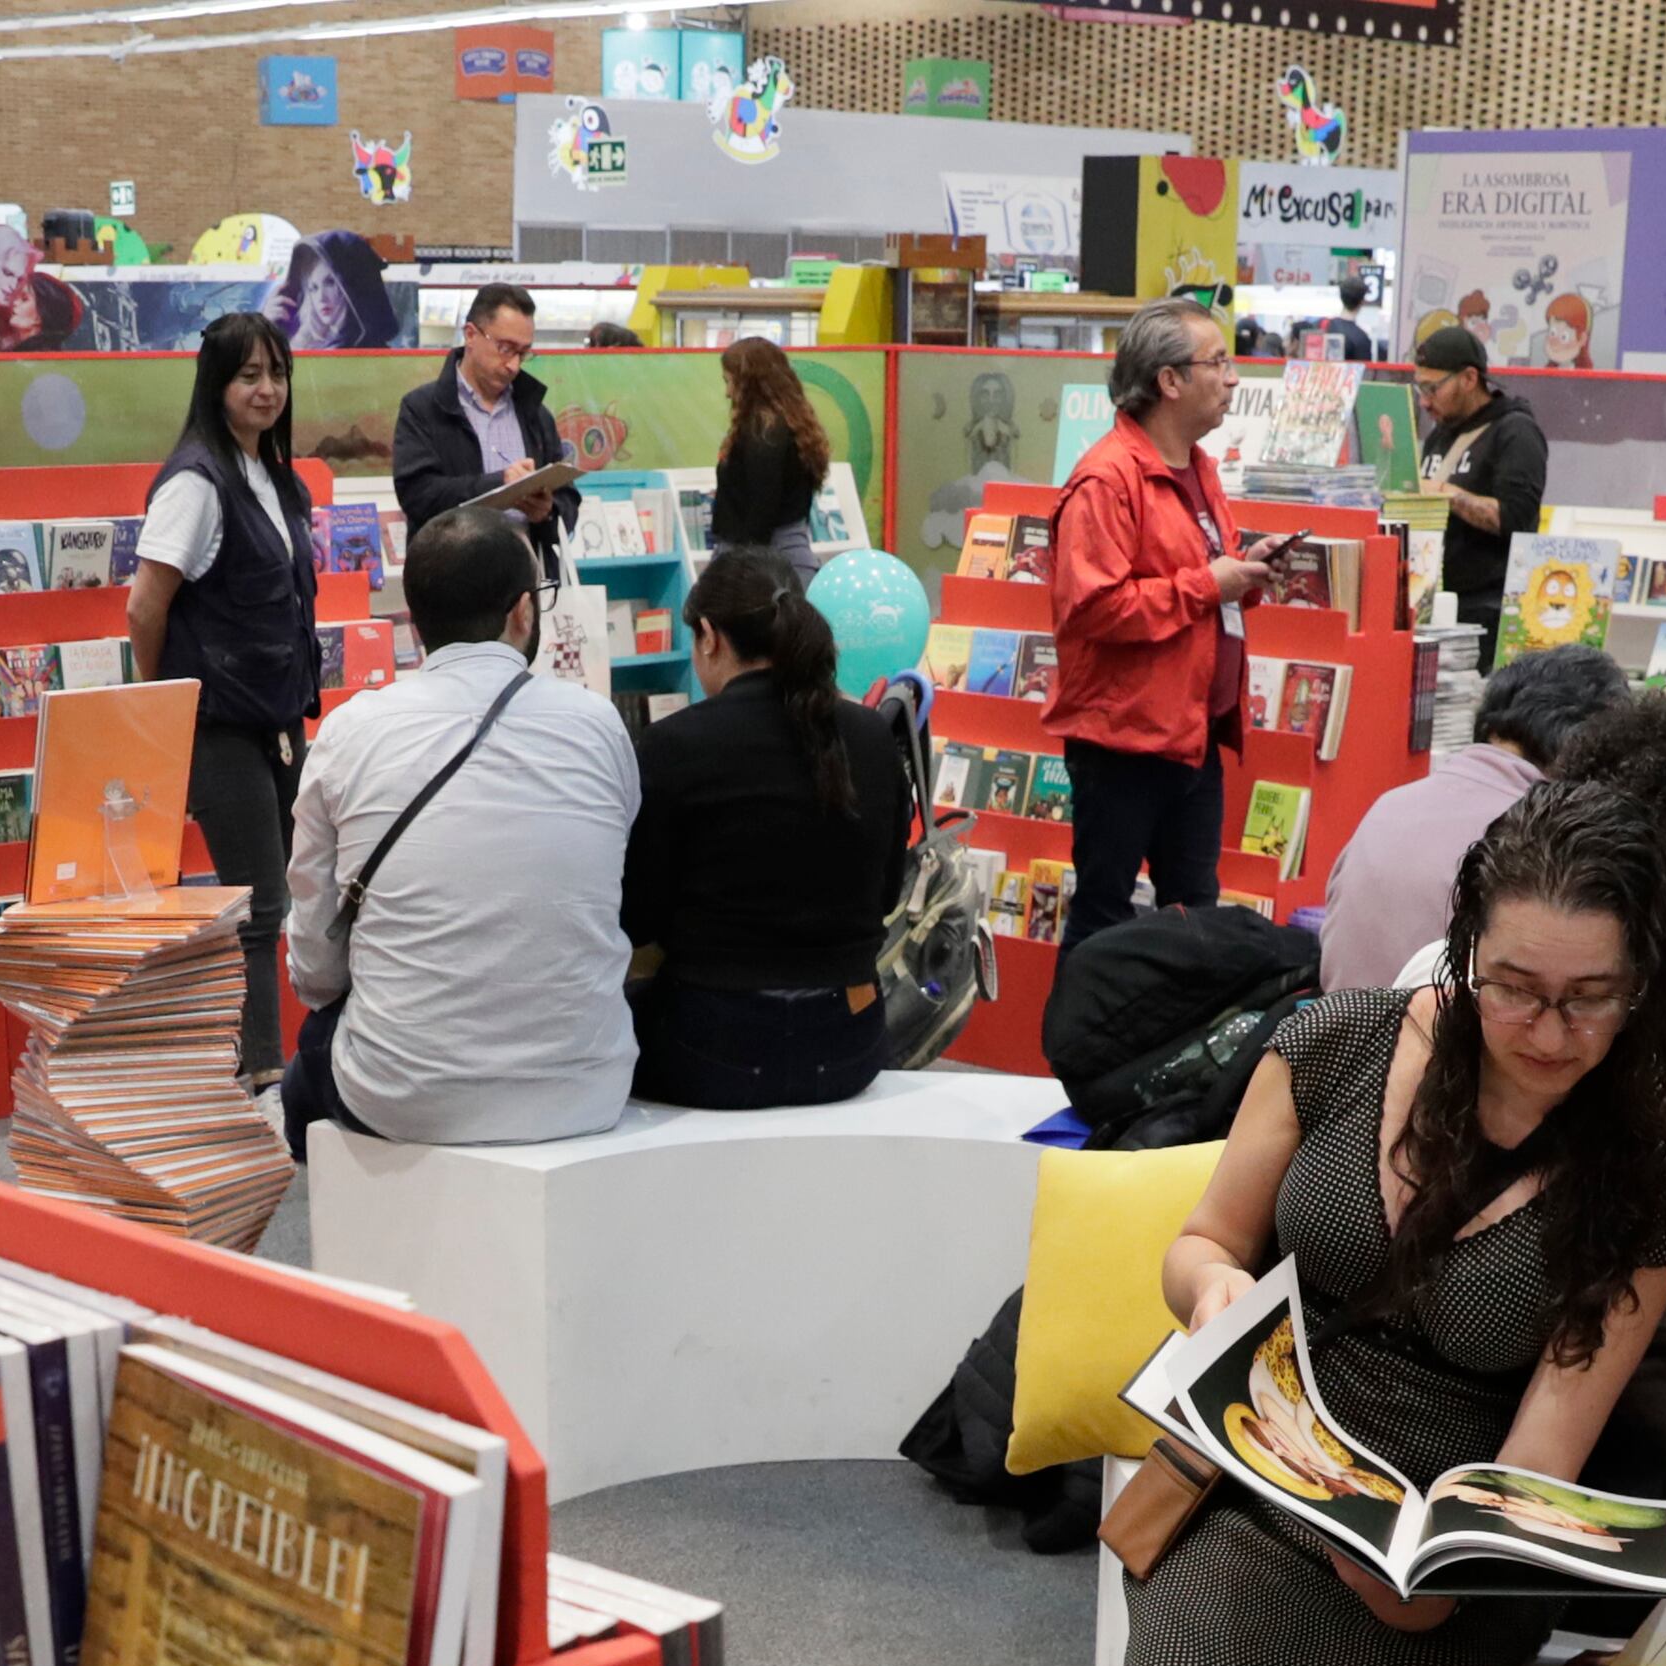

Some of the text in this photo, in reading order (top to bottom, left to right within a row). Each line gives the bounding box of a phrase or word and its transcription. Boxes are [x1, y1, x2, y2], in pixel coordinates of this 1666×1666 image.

[1484, 172, 1571, 187] ASOMBROSA
[1242, 183, 1275, 219] Mi
[1441, 191, 1592, 215] ERA DIGITAL
[1274, 268, 1312, 285] Caja
[1363, 275, 1380, 302] 3
[133, 1434, 370, 1616] ¡INCREÍBLE!
